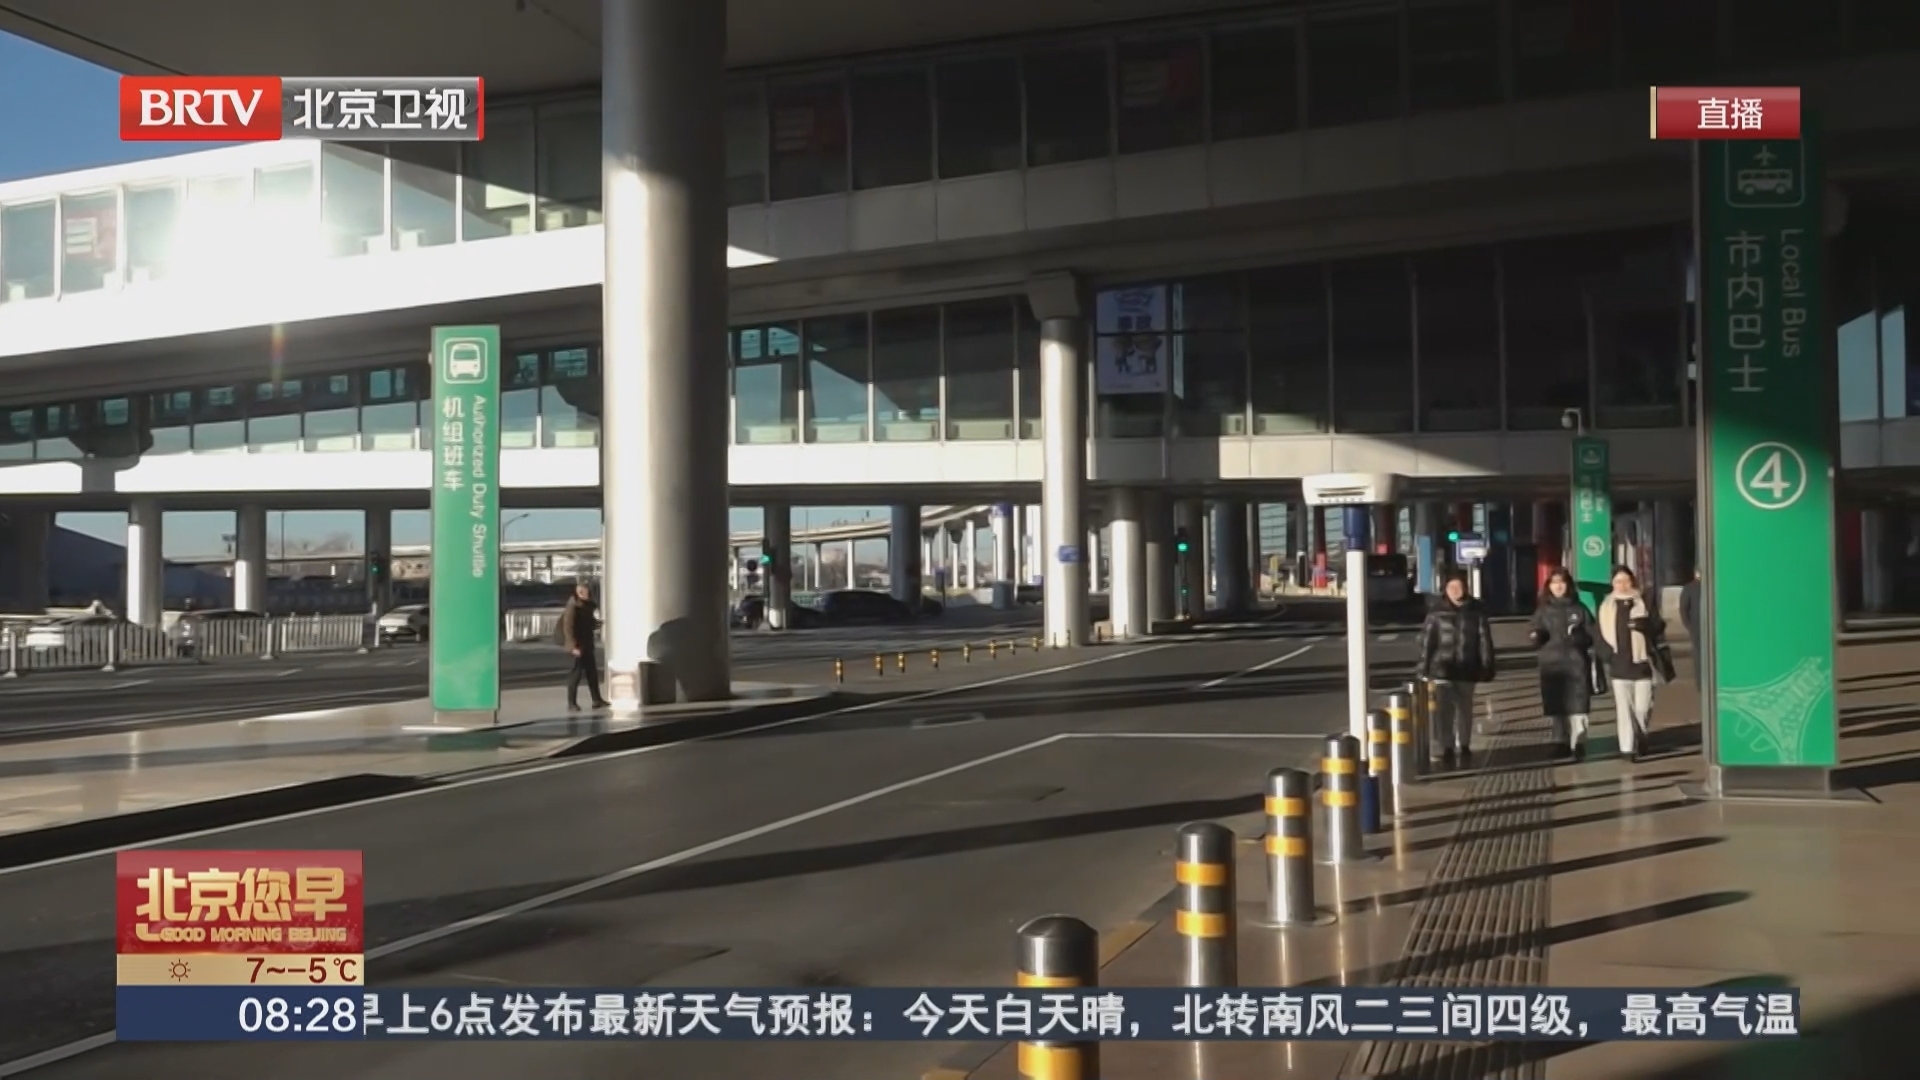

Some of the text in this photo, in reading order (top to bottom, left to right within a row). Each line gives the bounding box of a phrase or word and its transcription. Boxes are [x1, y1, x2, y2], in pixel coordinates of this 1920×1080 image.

[1725, 230, 1768, 392] 市内巴士
[1781, 228, 1807, 358] Local Bus
[442, 396, 465, 492] 机组班车
[470, 483, 487, 519] Duty
[472, 523, 487, 578] Shuttle
